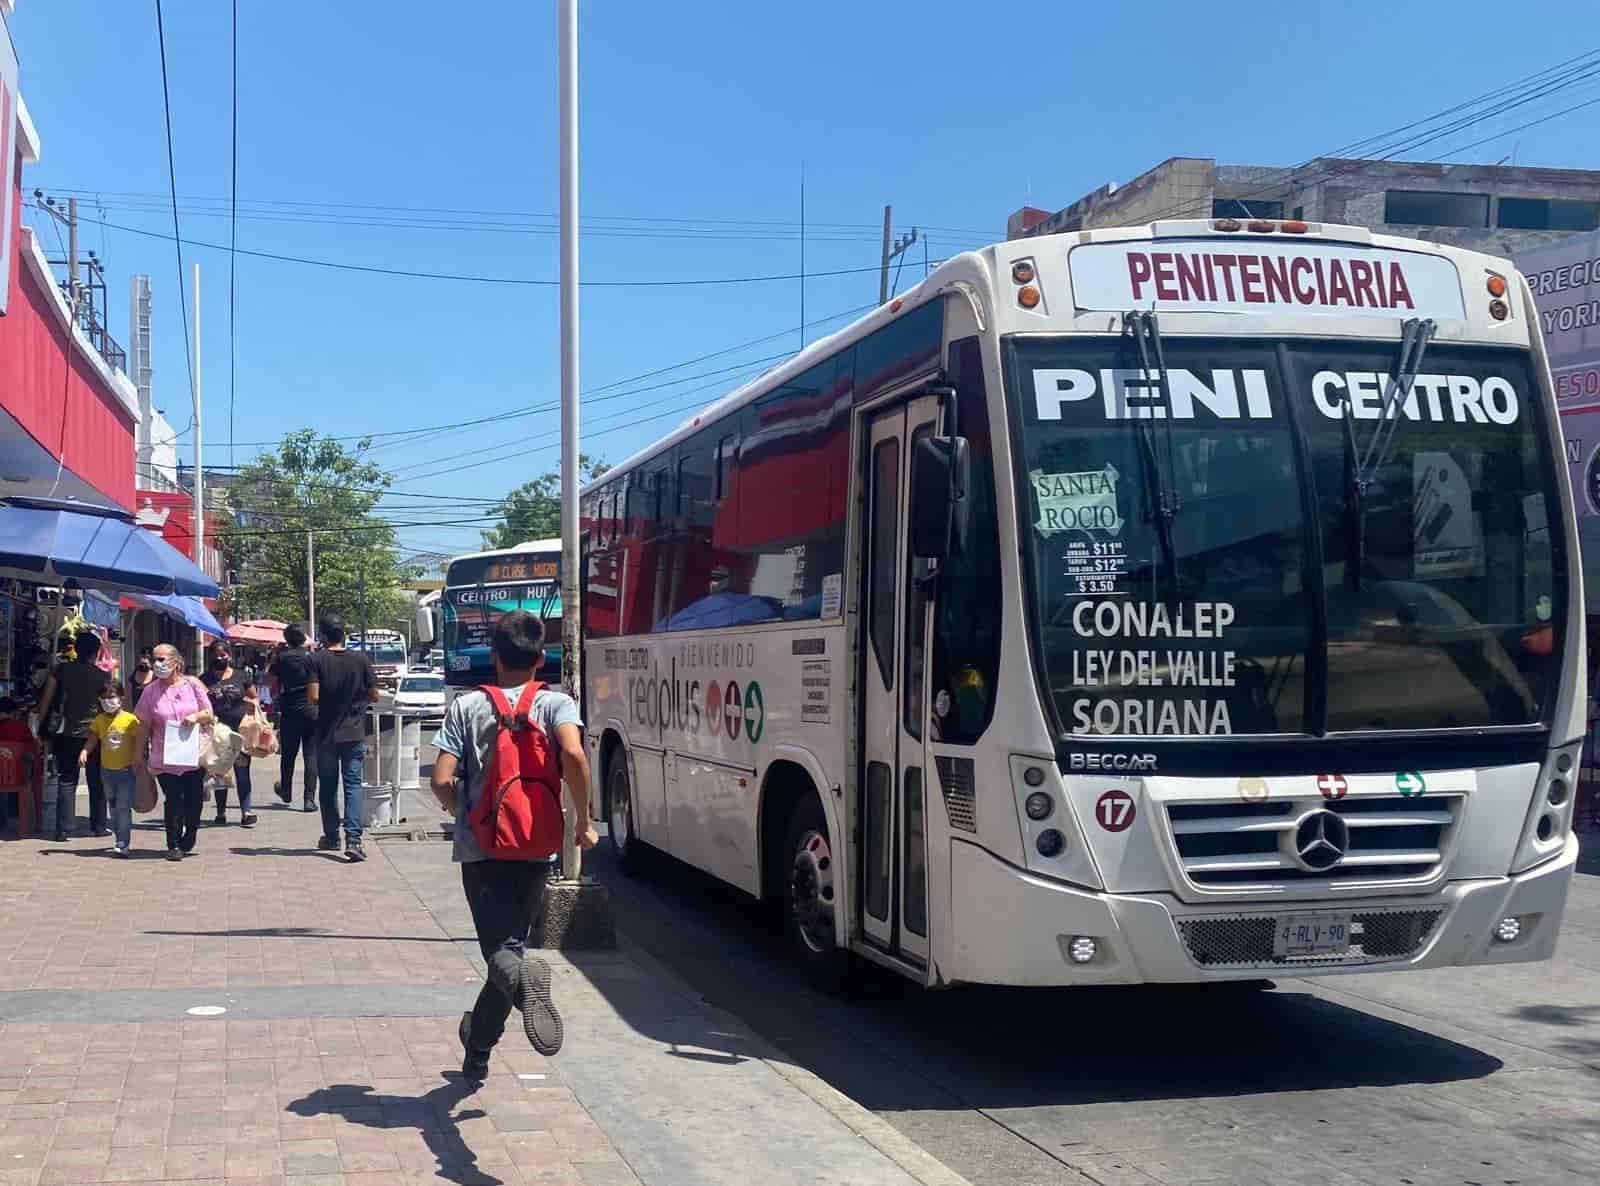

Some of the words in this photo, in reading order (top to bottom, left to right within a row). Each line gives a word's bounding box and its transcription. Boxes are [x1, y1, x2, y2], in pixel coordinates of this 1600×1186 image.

[1127, 252, 1416, 309] PENITENCIARIA
[1033, 368, 1273, 420] PENI
[1312, 370, 1519, 425] CENTRO
[1038, 472, 1115, 498] SANTA
[1045, 504, 1116, 530] ROCIO
[1089, 581, 1114, 592] 3.50
[1072, 601, 1236, 638] CONALEP
[1072, 650, 1115, 687] LEY
[1120, 650, 1163, 687] DEL
[1167, 650, 1236, 687] VALLE
[1072, 698, 1233, 736] SORIANA
[1070, 753, 1157, 770] BECCAR
[1100, 798, 1132, 825] 17
